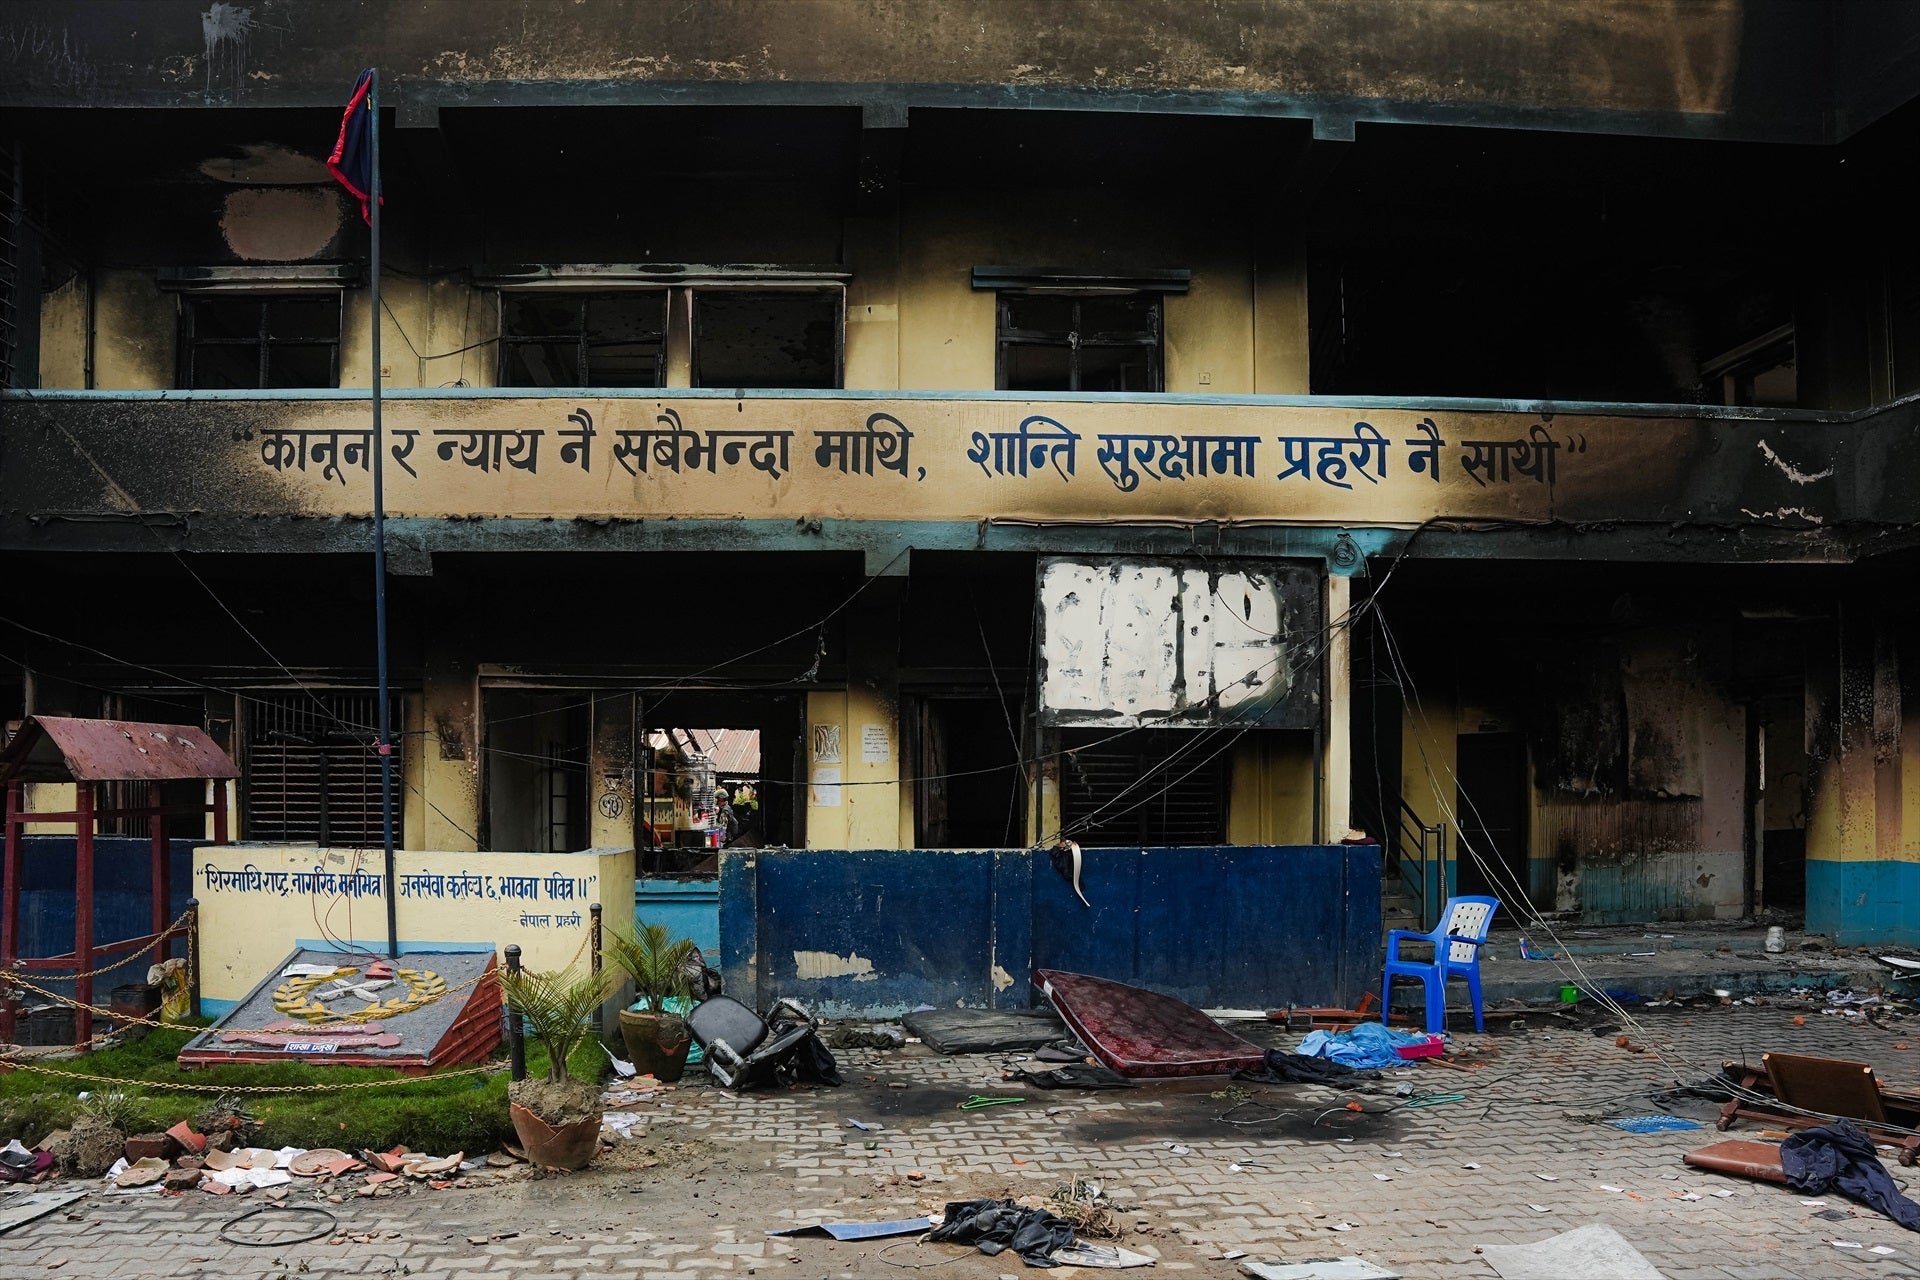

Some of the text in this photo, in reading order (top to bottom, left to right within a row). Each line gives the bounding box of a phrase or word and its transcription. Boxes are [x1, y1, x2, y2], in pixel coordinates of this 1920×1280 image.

[391, 429, 420, 479] र
[433, 429, 545, 474] न्याय
[557, 408, 597, 474] नै
[613, 408, 795, 480] सबैभन्दा
[813, 412, 926, 482] माथि,
[967, 415, 1082, 477] शान्ति
[1097, 434, 1261, 492] सुरक्षामा
[1278, 421, 1391, 490] प्रहरी
[1405, 418, 1445, 482] नै
[399, 868, 445, 900] जनसेवा
[500, 876, 542, 901] भावना
[554, 911, 582, 930] प्रहरी
